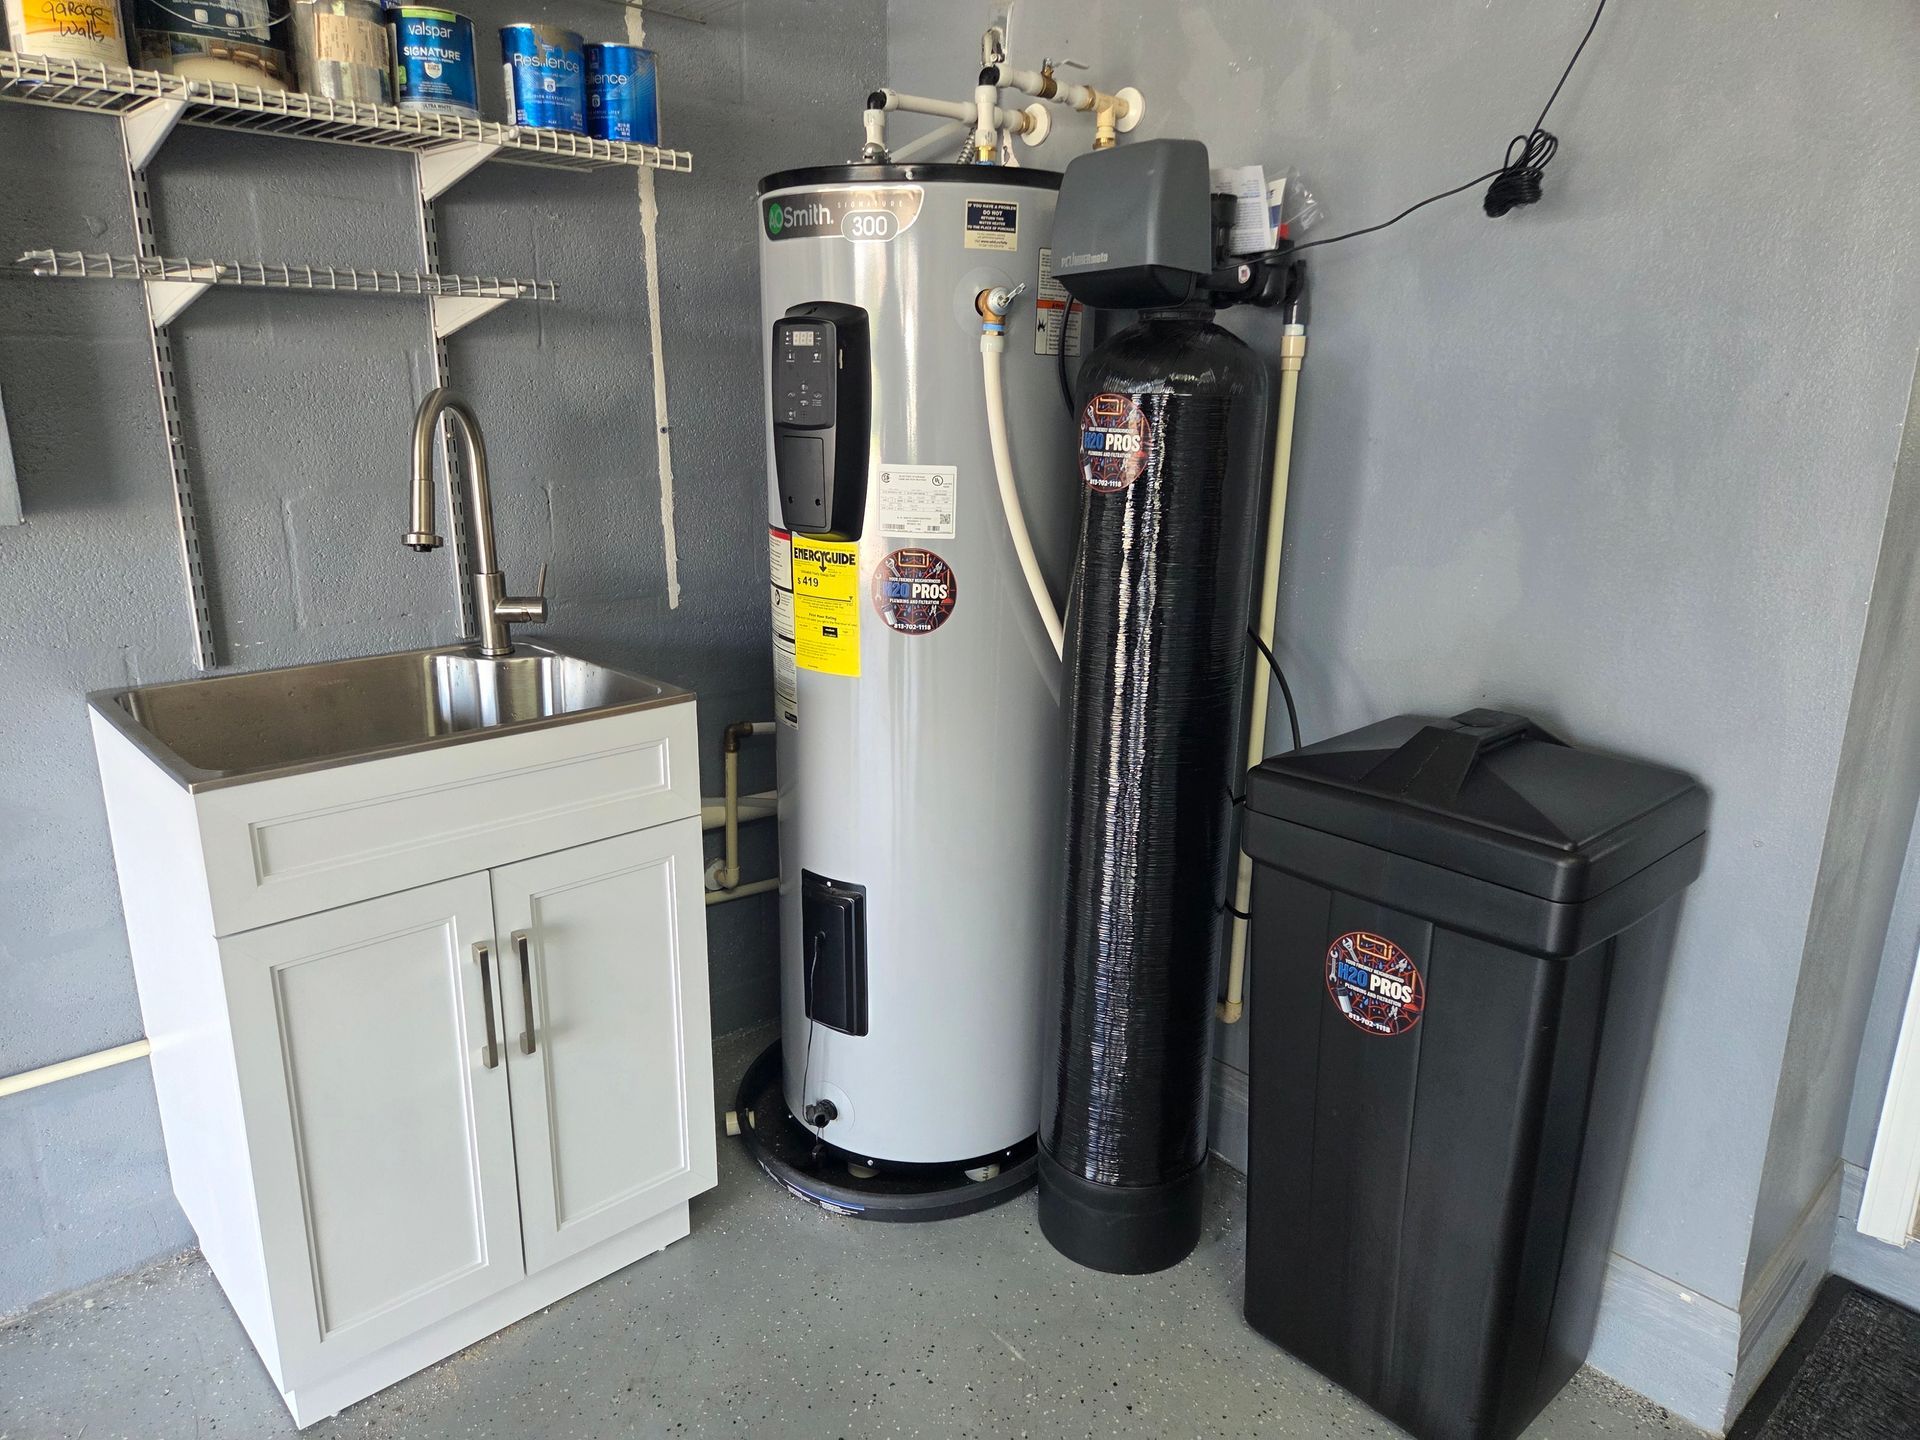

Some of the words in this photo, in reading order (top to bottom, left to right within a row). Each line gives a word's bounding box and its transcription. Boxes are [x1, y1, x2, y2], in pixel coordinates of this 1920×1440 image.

[60, 20, 105, 42] Walls
[408, 21, 454, 39] valspar
[403, 46, 461, 61] SIGNATURE
[837, 201, 903, 209] SIGNATURE
[852, 216, 888, 236] 300
[1105, 433, 1140, 452] PROS
[794, 547, 856, 566] ENERGYGUIDE
[802, 576, 819, 587] 419
[912, 583, 948, 599] PROS
[1370, 974, 1413, 1003] PROS
